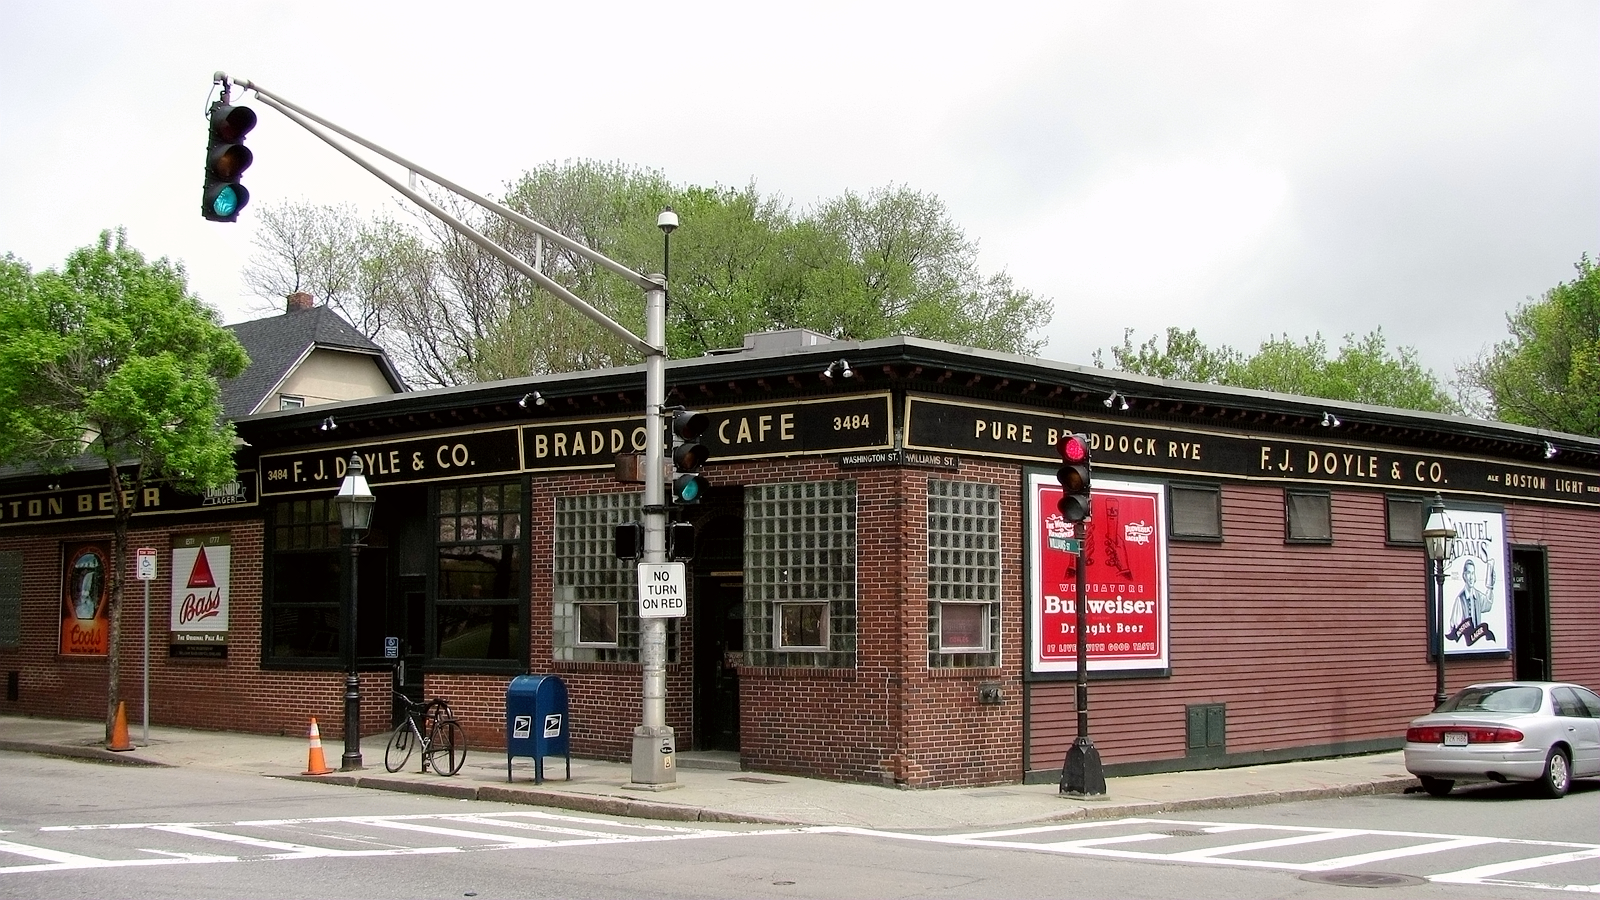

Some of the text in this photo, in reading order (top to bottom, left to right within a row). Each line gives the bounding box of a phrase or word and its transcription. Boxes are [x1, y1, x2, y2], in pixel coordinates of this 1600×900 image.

[536, 413, 870, 458] BRADDO CAFE 3484
[975, 419, 1202, 460] PURE BDDOCK RYE
[267, 470, 288, 481] 3484
[294, 461, 307, 482] F.
[314, 460, 328, 480] J.
[412, 452, 424, 471] &
[436, 444, 476, 468] CO.
[842, 453, 898, 464] WASHINGTON ST.
[906, 454, 955, 466] WILLIAMS ST.
[1261, 446, 1448, 484] F. J. DOYLE & CO.
[1505, 473, 1546, 490] BOSTON
[1556, 478, 1584, 494] LIGHT
[0, 488, 160, 520] TON BEER
[212, 494, 236, 505] LAGER
[1450, 519, 1492, 542] AMUEL
[1450, 540, 1488, 564] ADAMS
[654, 572, 670, 582] NO
[648, 585, 677, 596] TURN
[1059, 584, 1144, 592] WE FEATURE
[180, 587, 220, 625] Bass
[642, 598, 682, 610] ON RED
[70, 624, 102, 646] Coors
[1060, 622, 1144, 636] Drght Beer
[1047, 644, 1056, 652] IT
[1058, 644, 1076, 652] LIVE
[1108, 643, 1130, 652] GOOD
[1132, 642, 1154, 650] TASTE
